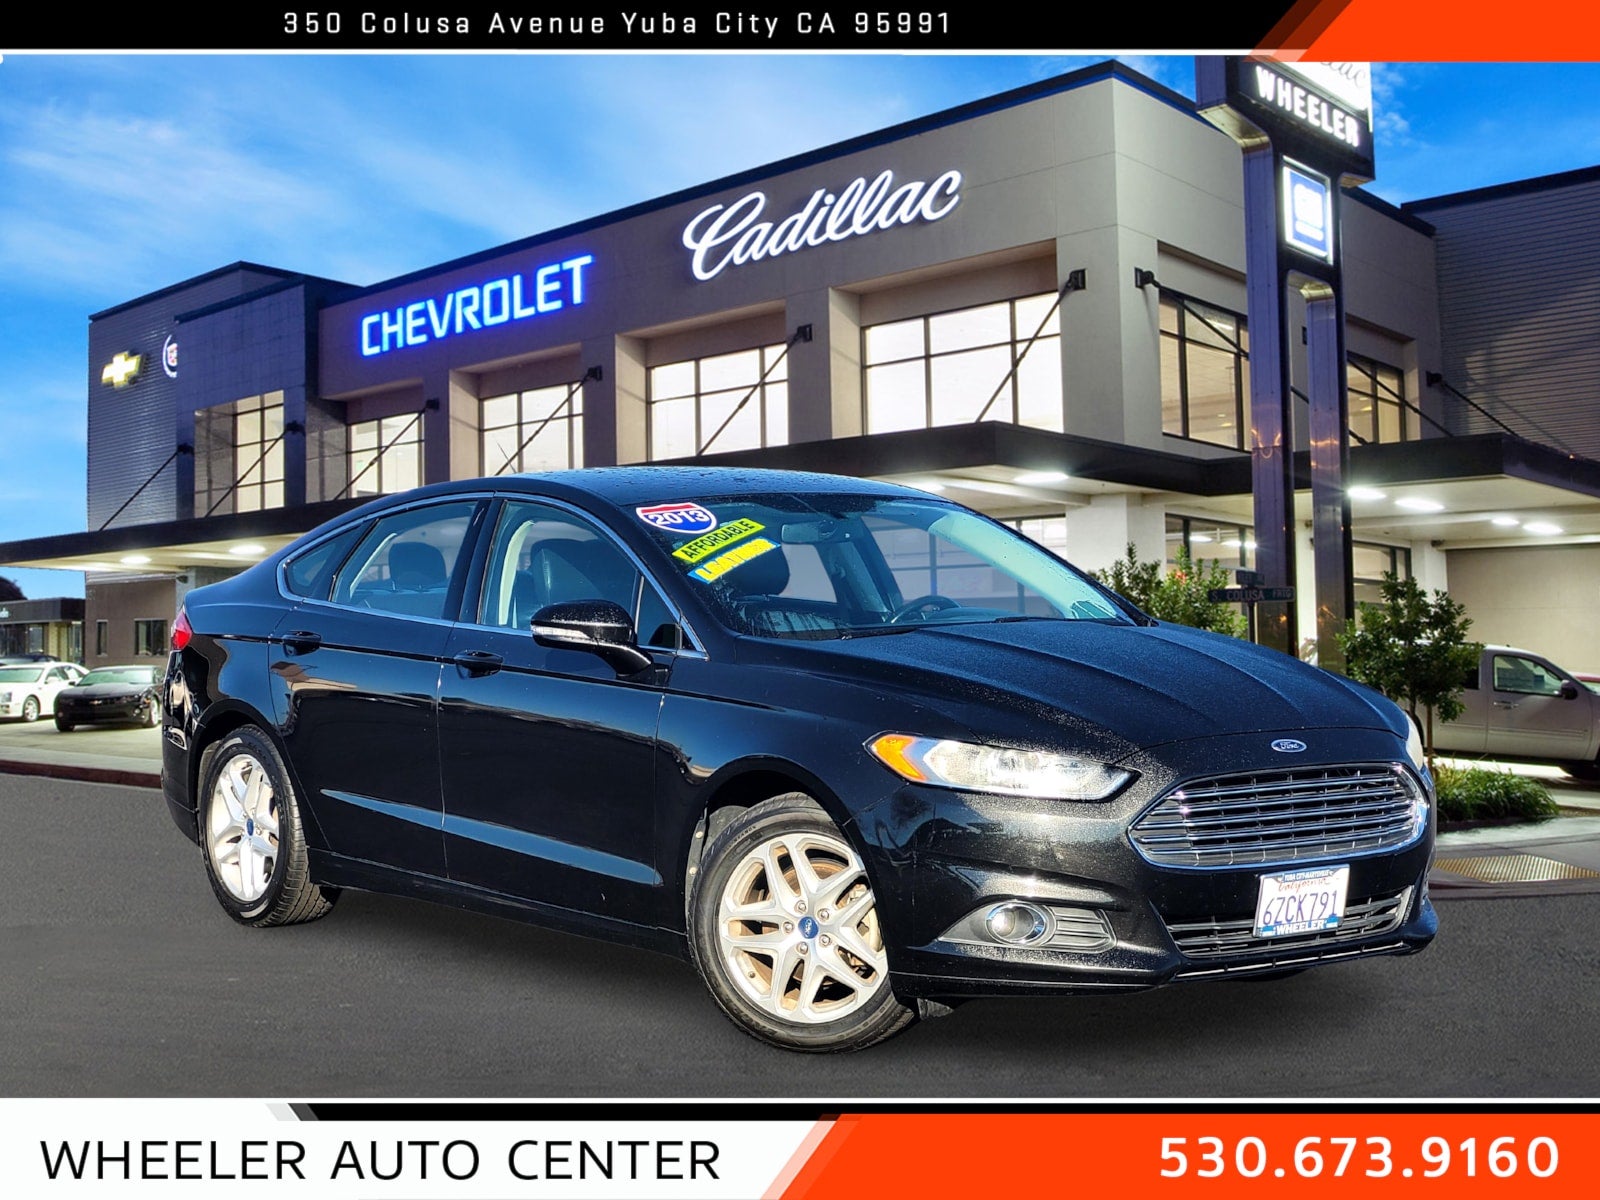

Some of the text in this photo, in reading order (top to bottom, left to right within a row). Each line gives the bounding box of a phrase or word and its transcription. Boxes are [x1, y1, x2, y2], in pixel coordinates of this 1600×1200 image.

[1256, 65, 1359, 148] WHEELER
[682, 169, 962, 281] Cadillac
[361, 254, 593, 357] CHEVROLET
[648, 509, 706, 526] 2013
[681, 519, 755, 559] AFFORDABLE
[1226, 588, 1265, 601] COLUSA
[1262, 889, 1338, 926] 6ZCK791
[1276, 919, 1324, 936] WHEELER
